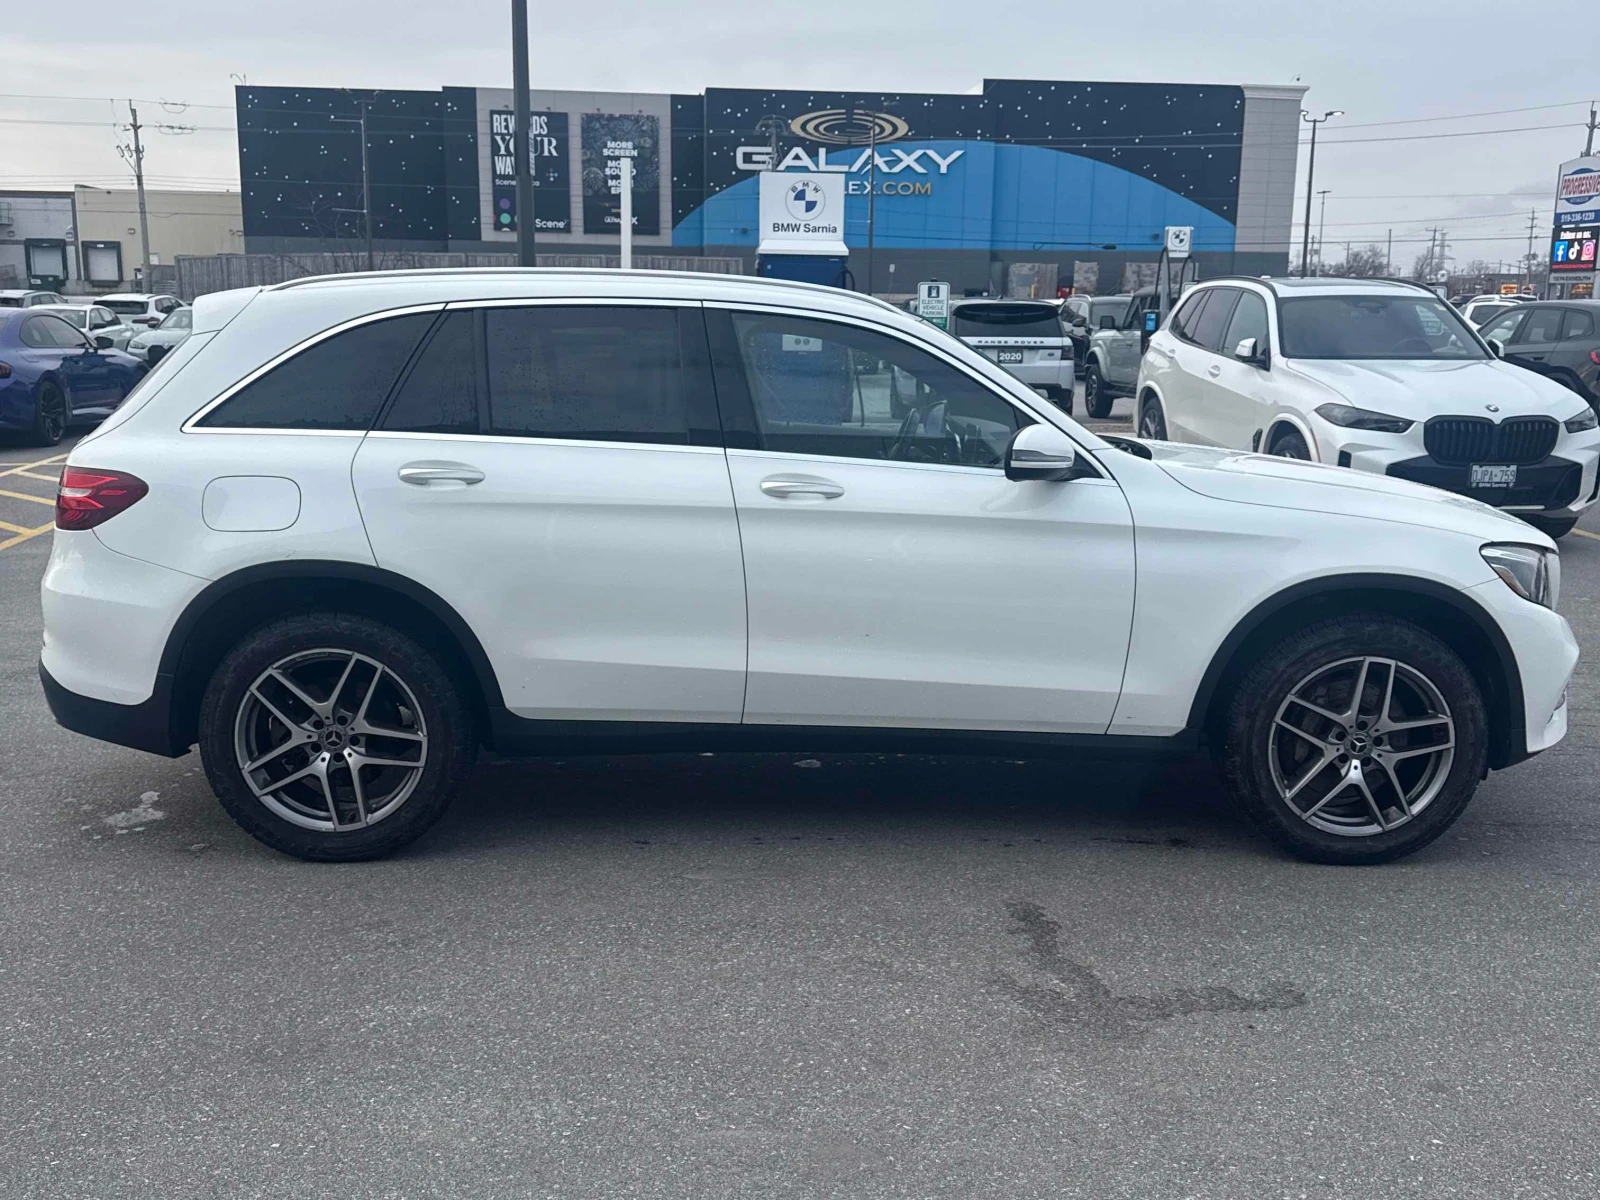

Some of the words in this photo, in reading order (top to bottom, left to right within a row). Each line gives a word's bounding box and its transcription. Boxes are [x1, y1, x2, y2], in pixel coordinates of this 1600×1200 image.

[493, 113, 548, 135] REWDS
[607, 141, 633, 149] MORE
[602, 148, 638, 157] SCREEN
[494, 156, 515, 175] WA
[735, 146, 965, 175] GALAXY
[772, 222, 801, 233] BMW
[803, 222, 838, 234] Sarnia
[999, 352, 1022, 360] 2020
